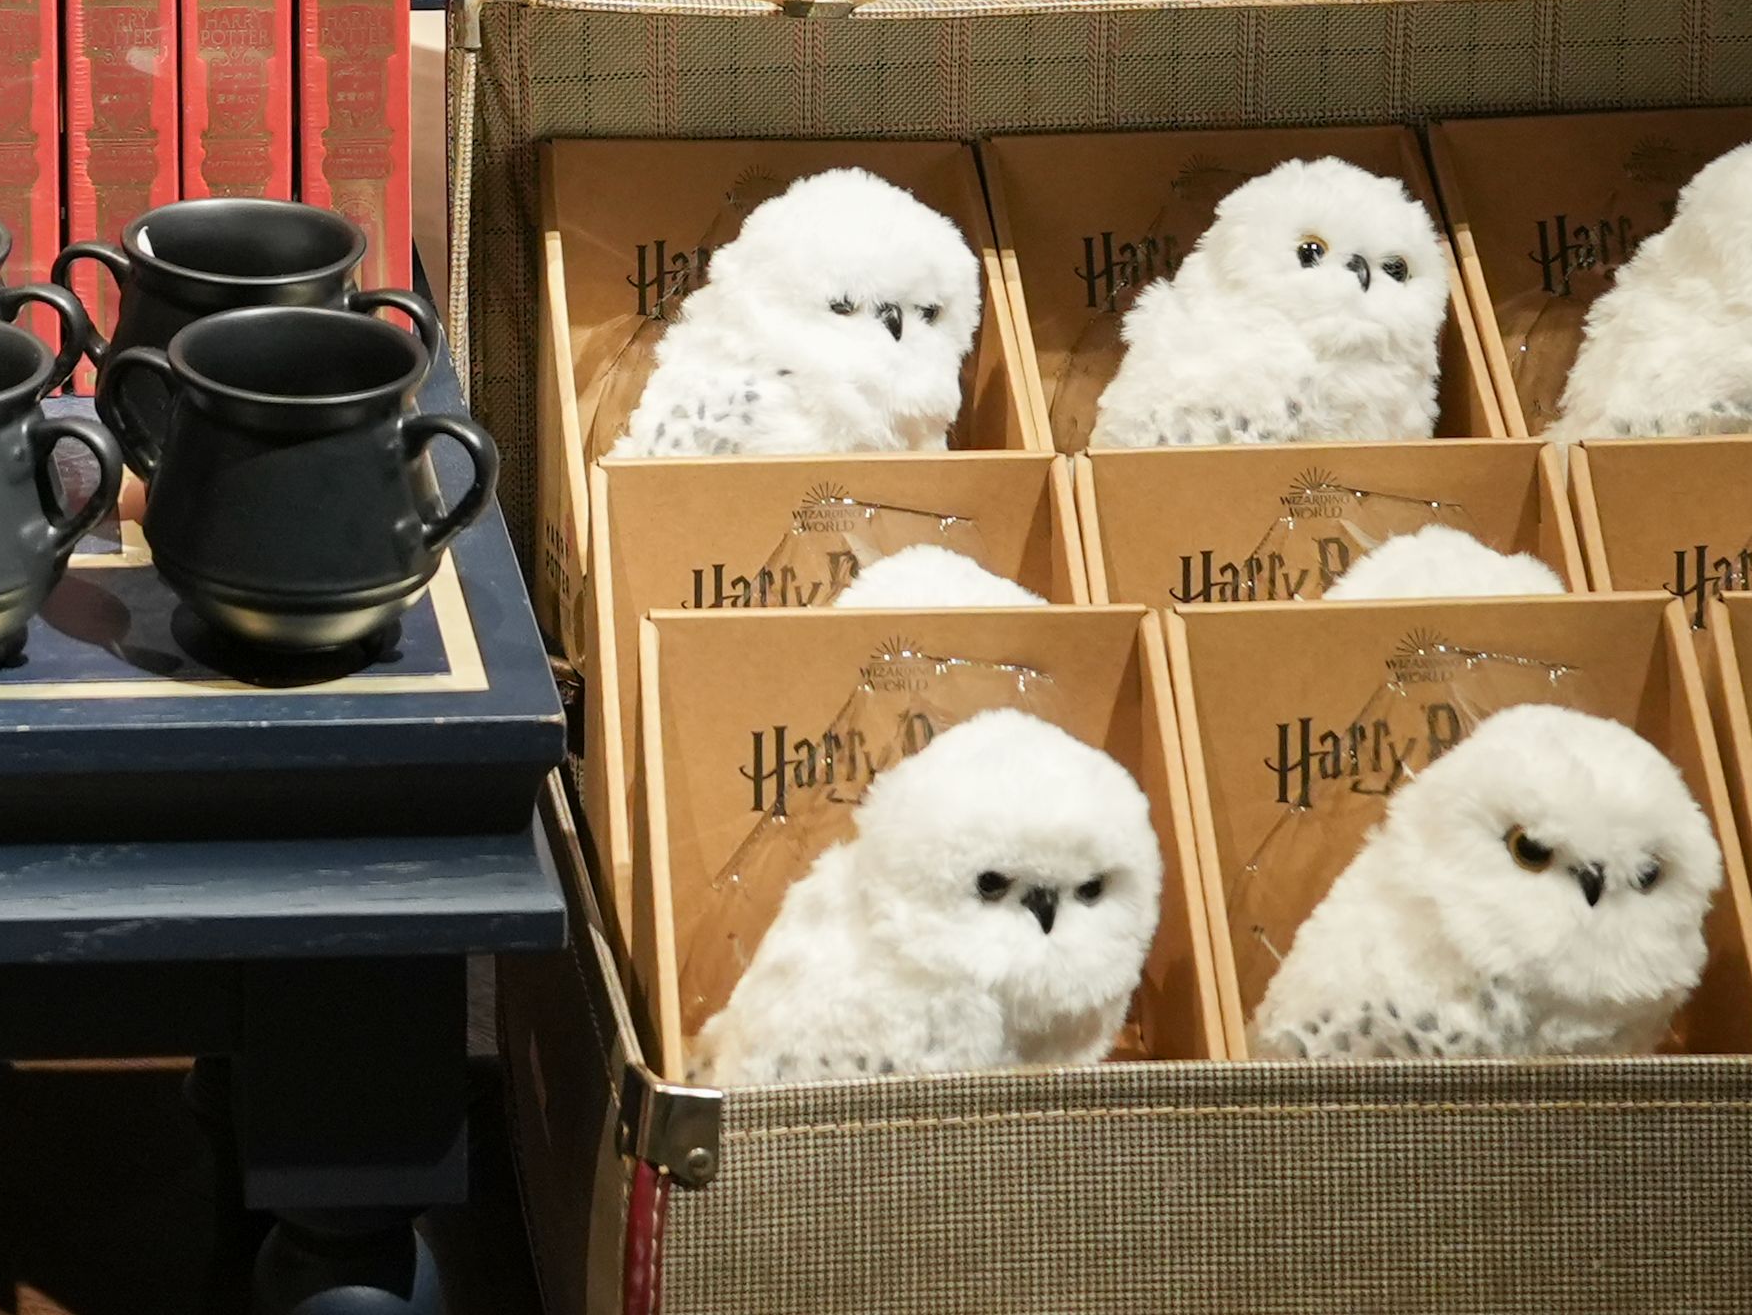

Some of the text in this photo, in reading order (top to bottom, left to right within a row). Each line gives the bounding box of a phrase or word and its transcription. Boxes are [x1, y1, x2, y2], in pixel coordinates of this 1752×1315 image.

[204, 12, 264, 30] HARRY
[323, 12, 383, 29] HARRY
[200, 30, 269, 47] POTTER
[321, 28, 389, 45] POTTER
[1528, 214, 1634, 296] Harr
[1074, 231, 1182, 312] Harr
[1279, 494, 1351, 507] WIZARDING
[792, 509, 864, 521] WIZARDING
[1288, 506, 1343, 519] WORLD
[800, 520, 855, 533] WORLD
[1169, 549, 1311, 601] Harry
[681, 563, 824, 608] Harry
[1393, 669, 1455, 683] WORLD
[739, 723, 889, 817] Harry
[1264, 717, 1417, 809] Harry
